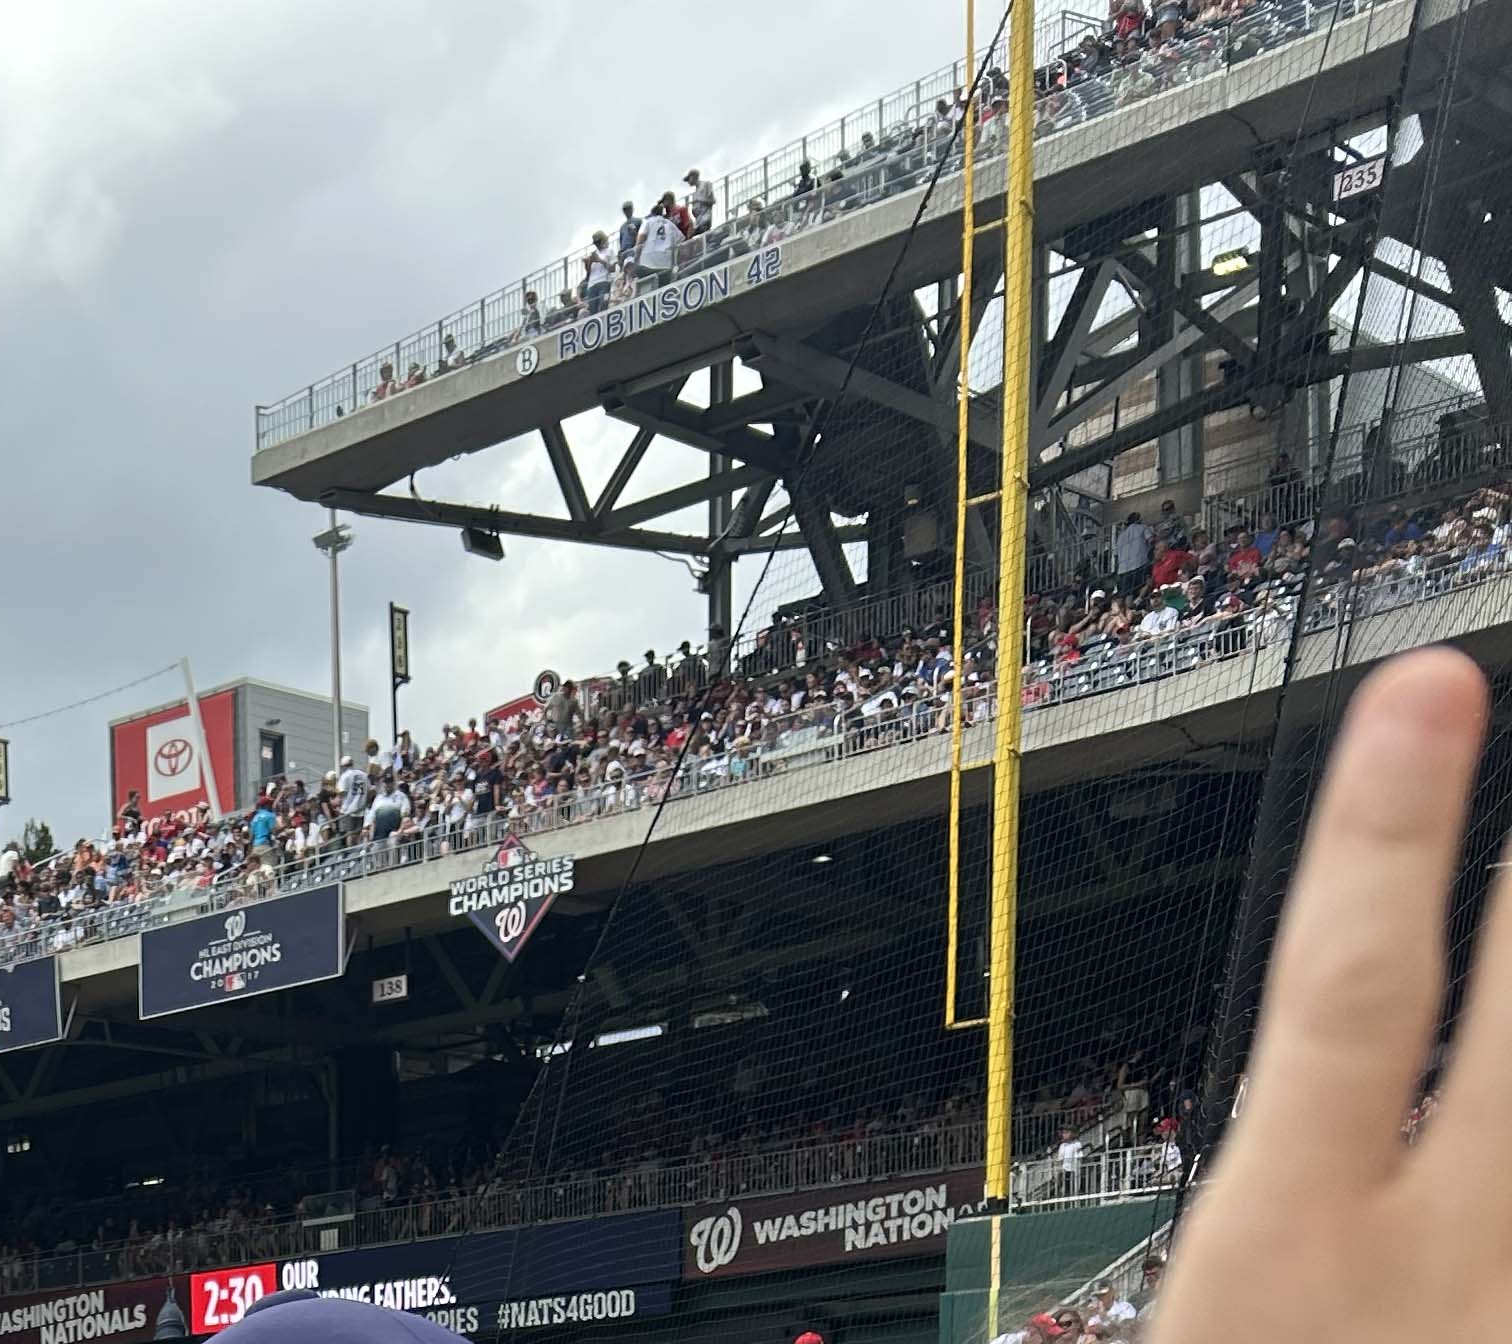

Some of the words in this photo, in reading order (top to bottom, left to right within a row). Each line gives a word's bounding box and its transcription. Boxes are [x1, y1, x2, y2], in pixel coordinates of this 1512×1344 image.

[1343, 161, 1377, 193] 235
[559, 266, 730, 359] ROBINSON
[747, 247, 782, 285] 42
[449, 871, 575, 916] CHAMPIONS
[450, 871, 510, 896] WORLD
[513, 856, 574, 881] SERIES
[190, 943, 282, 981] CHAMPIONS
[211, 943, 233, 957] EAST
[233, 933, 274, 953] DIVISION
[379, 979, 404, 998] 138
[753, 1183, 947, 1245] WASHINGTON
[281, 1260, 320, 1289] OUR
[203, 1274, 264, 1327] 2:30
[497, 1289, 636, 1330] #NATS4GOOD
